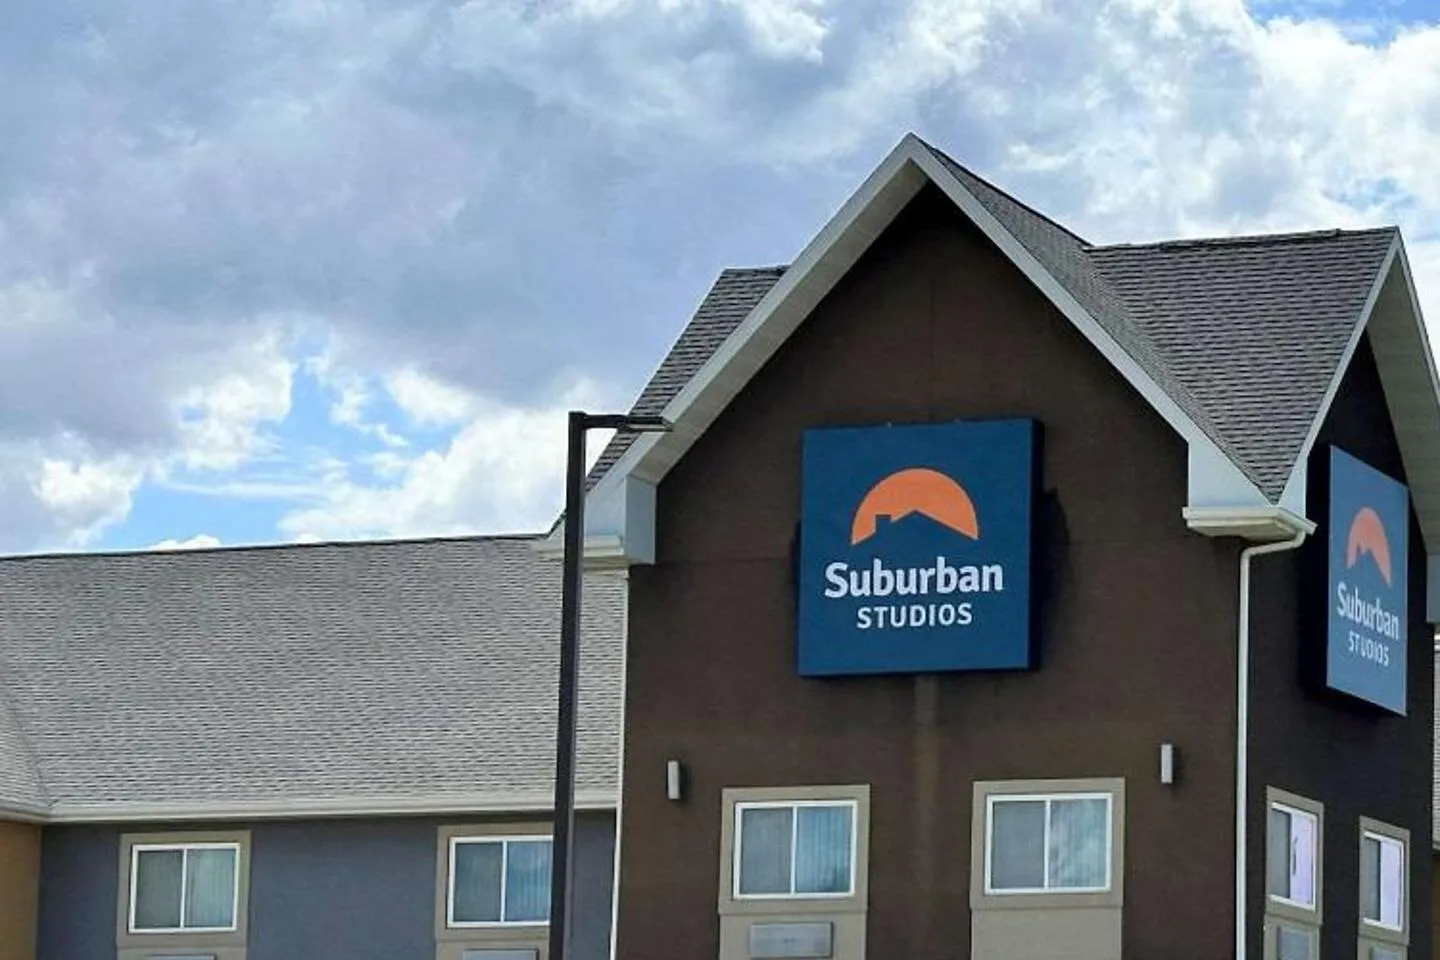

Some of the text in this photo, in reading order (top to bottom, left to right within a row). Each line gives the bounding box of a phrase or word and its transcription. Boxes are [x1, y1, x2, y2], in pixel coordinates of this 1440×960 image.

[824, 556, 1004, 598] Suburban
[857, 603, 972, 628] STUDIOS
[1337, 581, 1399, 641] Suburban
[1348, 630, 1389, 667] STUDIOS
